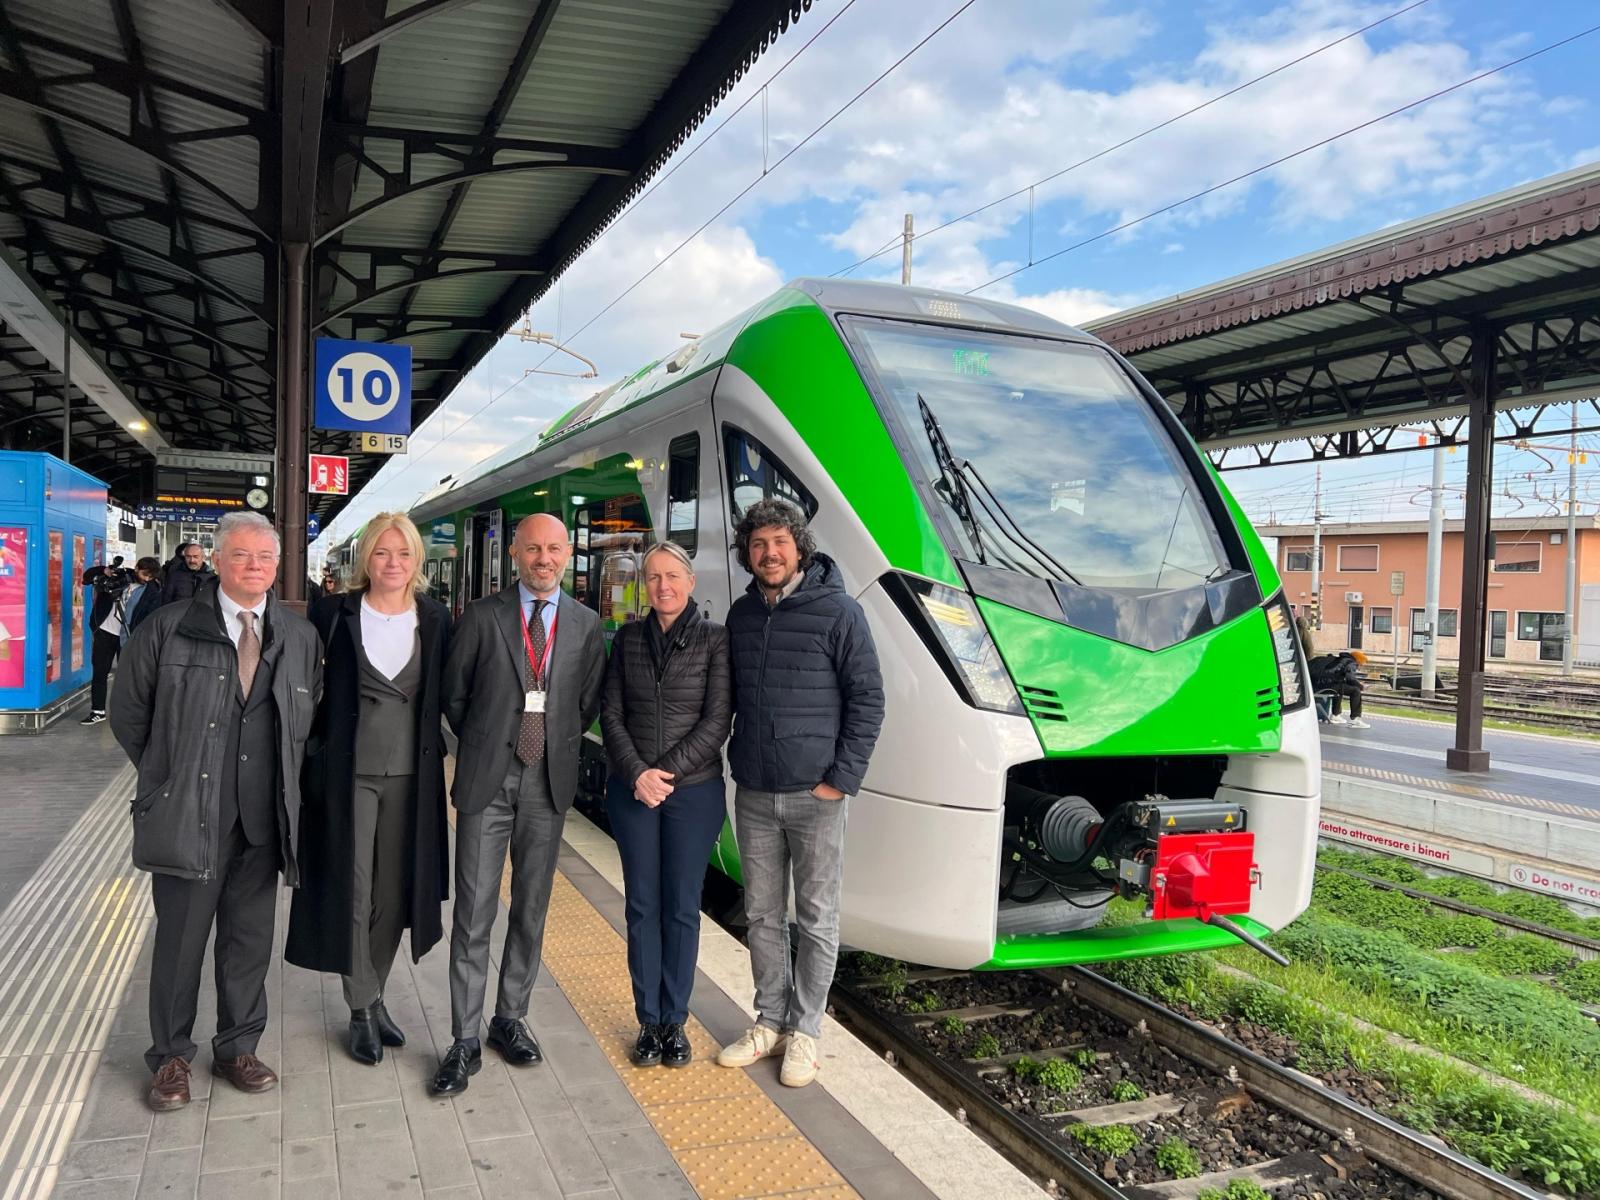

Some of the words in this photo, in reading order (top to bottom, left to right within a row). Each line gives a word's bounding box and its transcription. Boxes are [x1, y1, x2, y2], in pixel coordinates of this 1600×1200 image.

[337, 367, 392, 406] 10
[368, 435, 377, 447] 6
[387, 437, 403, 449] 15
[1350, 829, 1410, 851] attraversare
[1418, 843, 1450, 861] binari
[1532, 872, 1549, 886] Do
[1553, 880, 1574, 892] not
